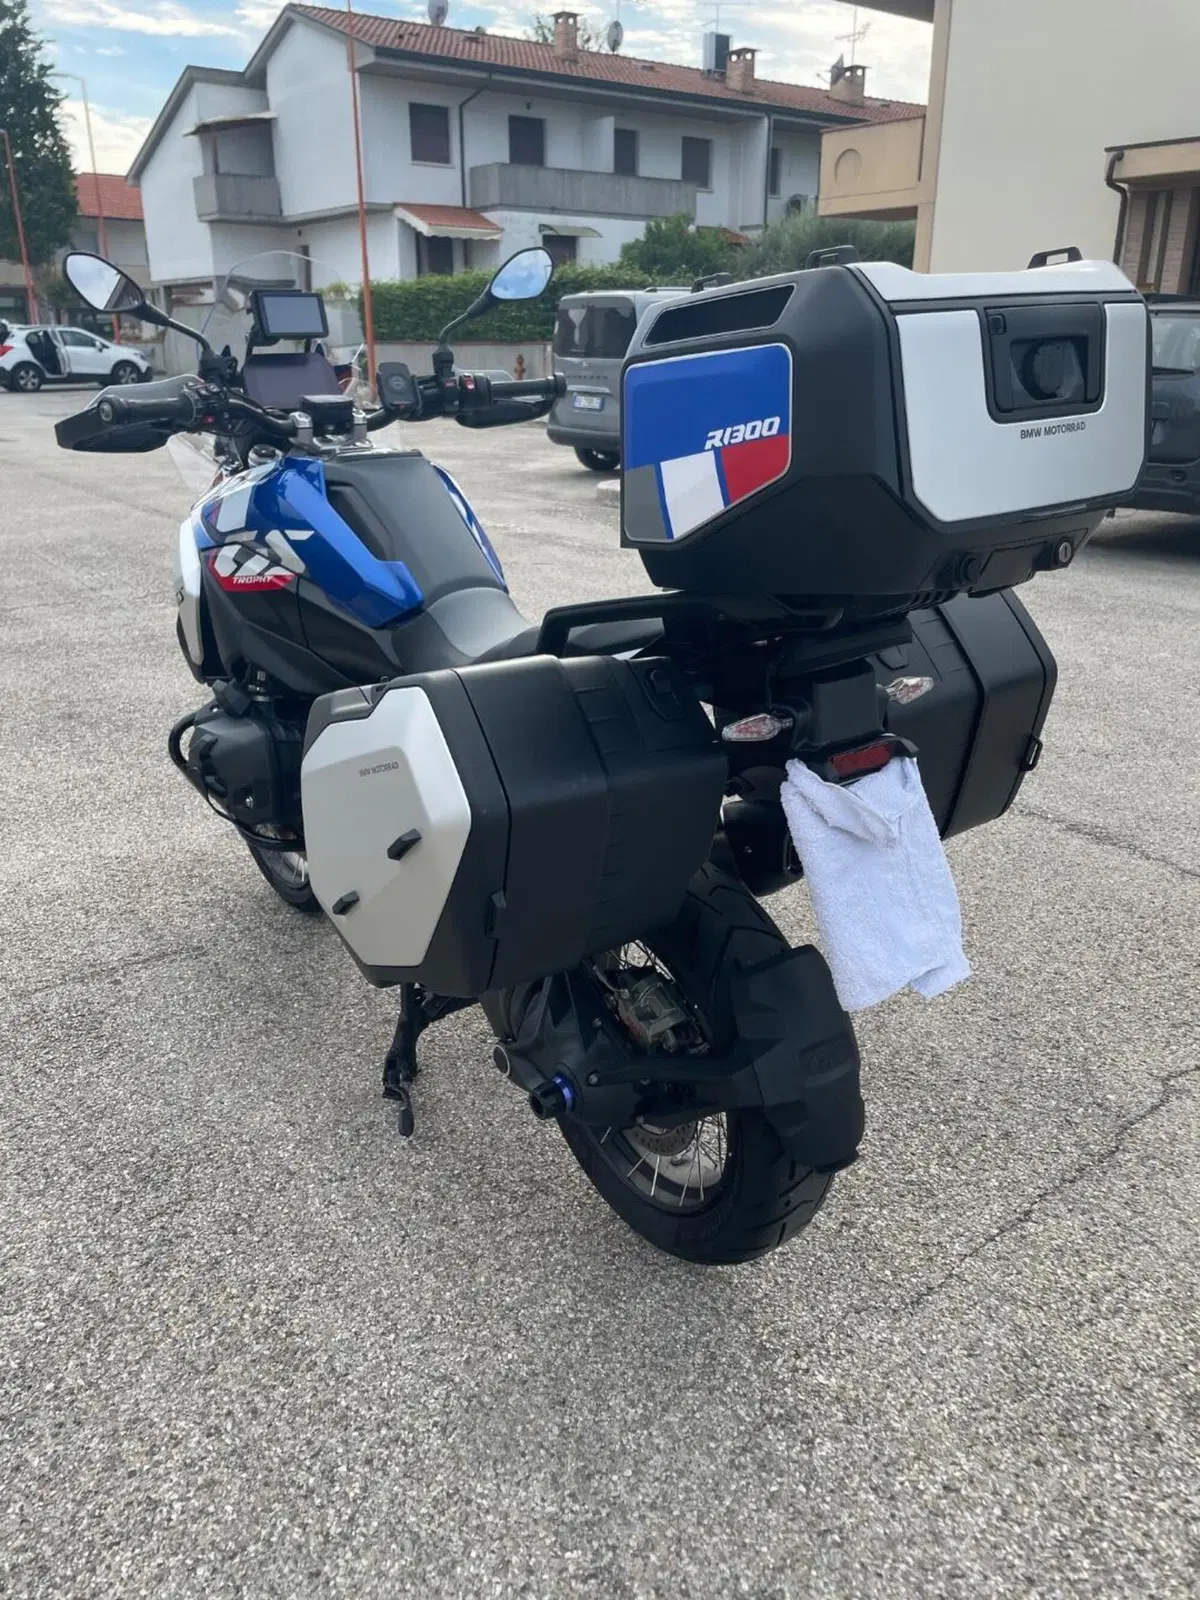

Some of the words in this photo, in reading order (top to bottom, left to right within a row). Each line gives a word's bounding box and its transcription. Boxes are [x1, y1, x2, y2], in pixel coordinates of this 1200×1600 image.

[704, 416, 781, 451] R1300
[1020, 427, 1042, 439] BMW
[1043, 421, 1086, 436] MOTORRAD
[232, 575, 275, 585] TROPHY
